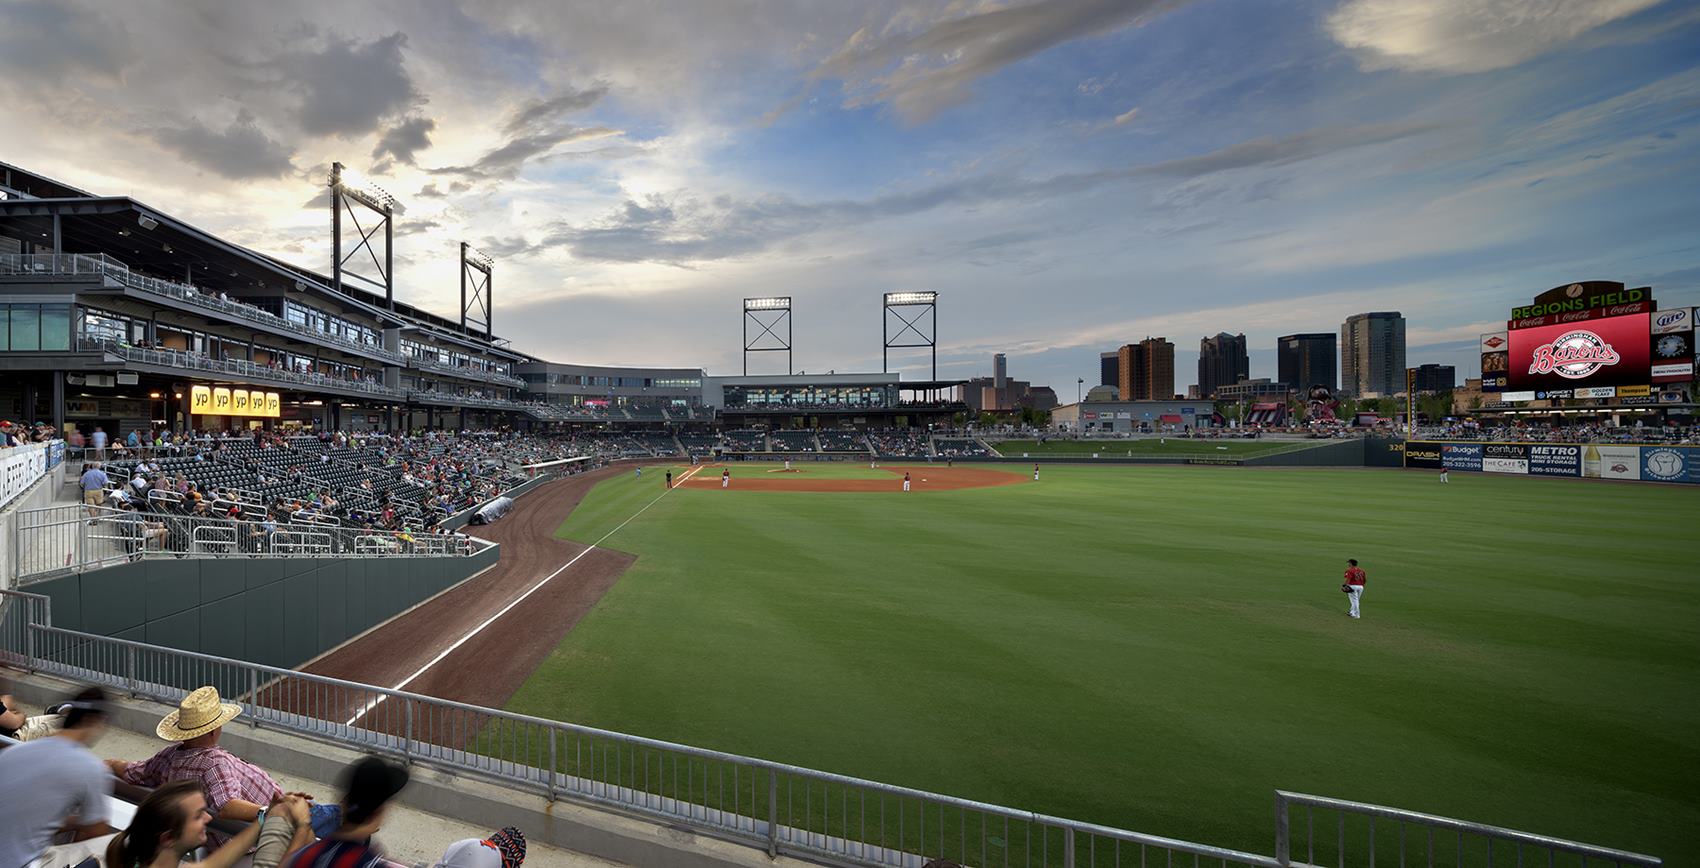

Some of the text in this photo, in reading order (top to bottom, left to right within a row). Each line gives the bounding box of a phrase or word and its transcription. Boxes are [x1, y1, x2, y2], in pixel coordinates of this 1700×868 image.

[1512, 290, 1643, 319] REGIONS FIELD
[1610, 303, 1643, 316] Coca-Cola
[1556, 333, 1597, 347] BIRMINGHAM
[1529, 343, 1620, 374] Barons
[66, 402, 97, 412] WM
[195, 393, 278, 410] yp yp yp yp yp
[1452, 446, 1479, 455] Budget
[1486, 445, 1524, 455] century
[1531, 446, 1578, 455] METRO
[1531, 466, 1577, 474] 205-STORAGE
